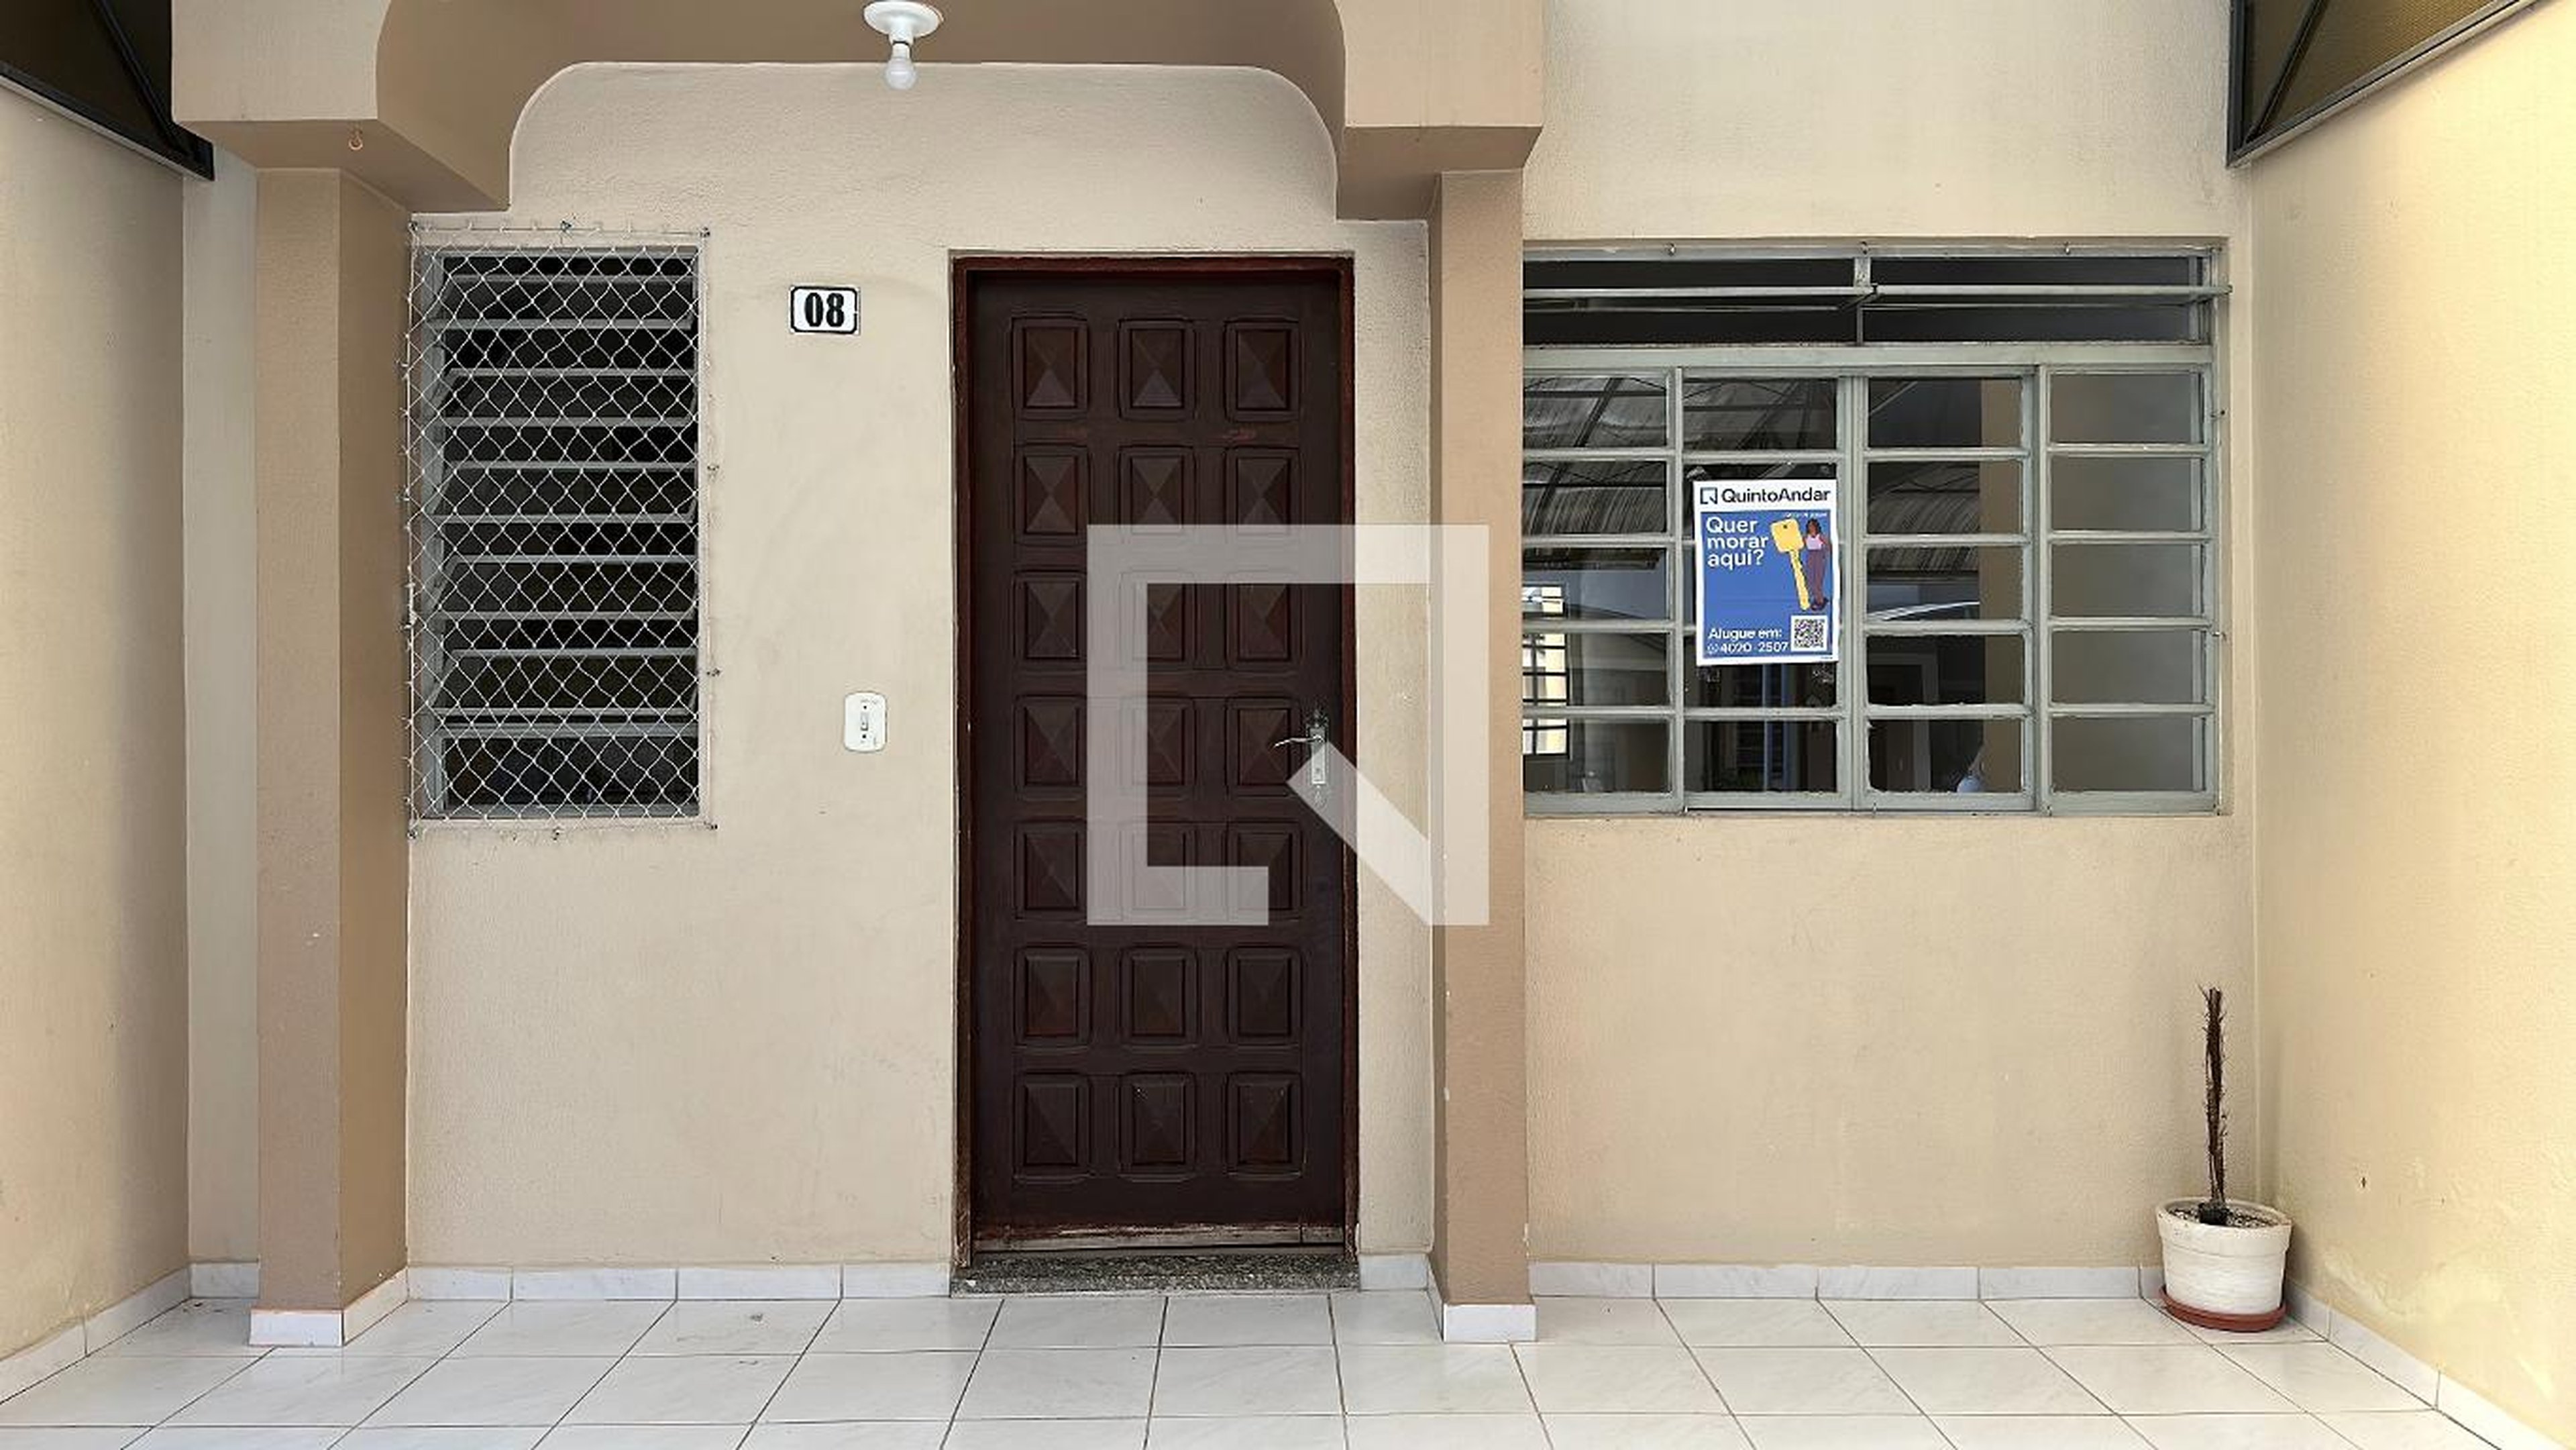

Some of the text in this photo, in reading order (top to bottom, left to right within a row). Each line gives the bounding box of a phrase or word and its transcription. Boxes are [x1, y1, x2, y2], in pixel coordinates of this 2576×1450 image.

[804, 293, 845, 327] 08
[1721, 487, 1830, 503] QuintoAndar
[1706, 517, 1757, 533] Quer
[1707, 537, 1768, 549] morar
[1708, 550, 1764, 570] aqui?
[1709, 629, 1782, 641] Alugue em:
